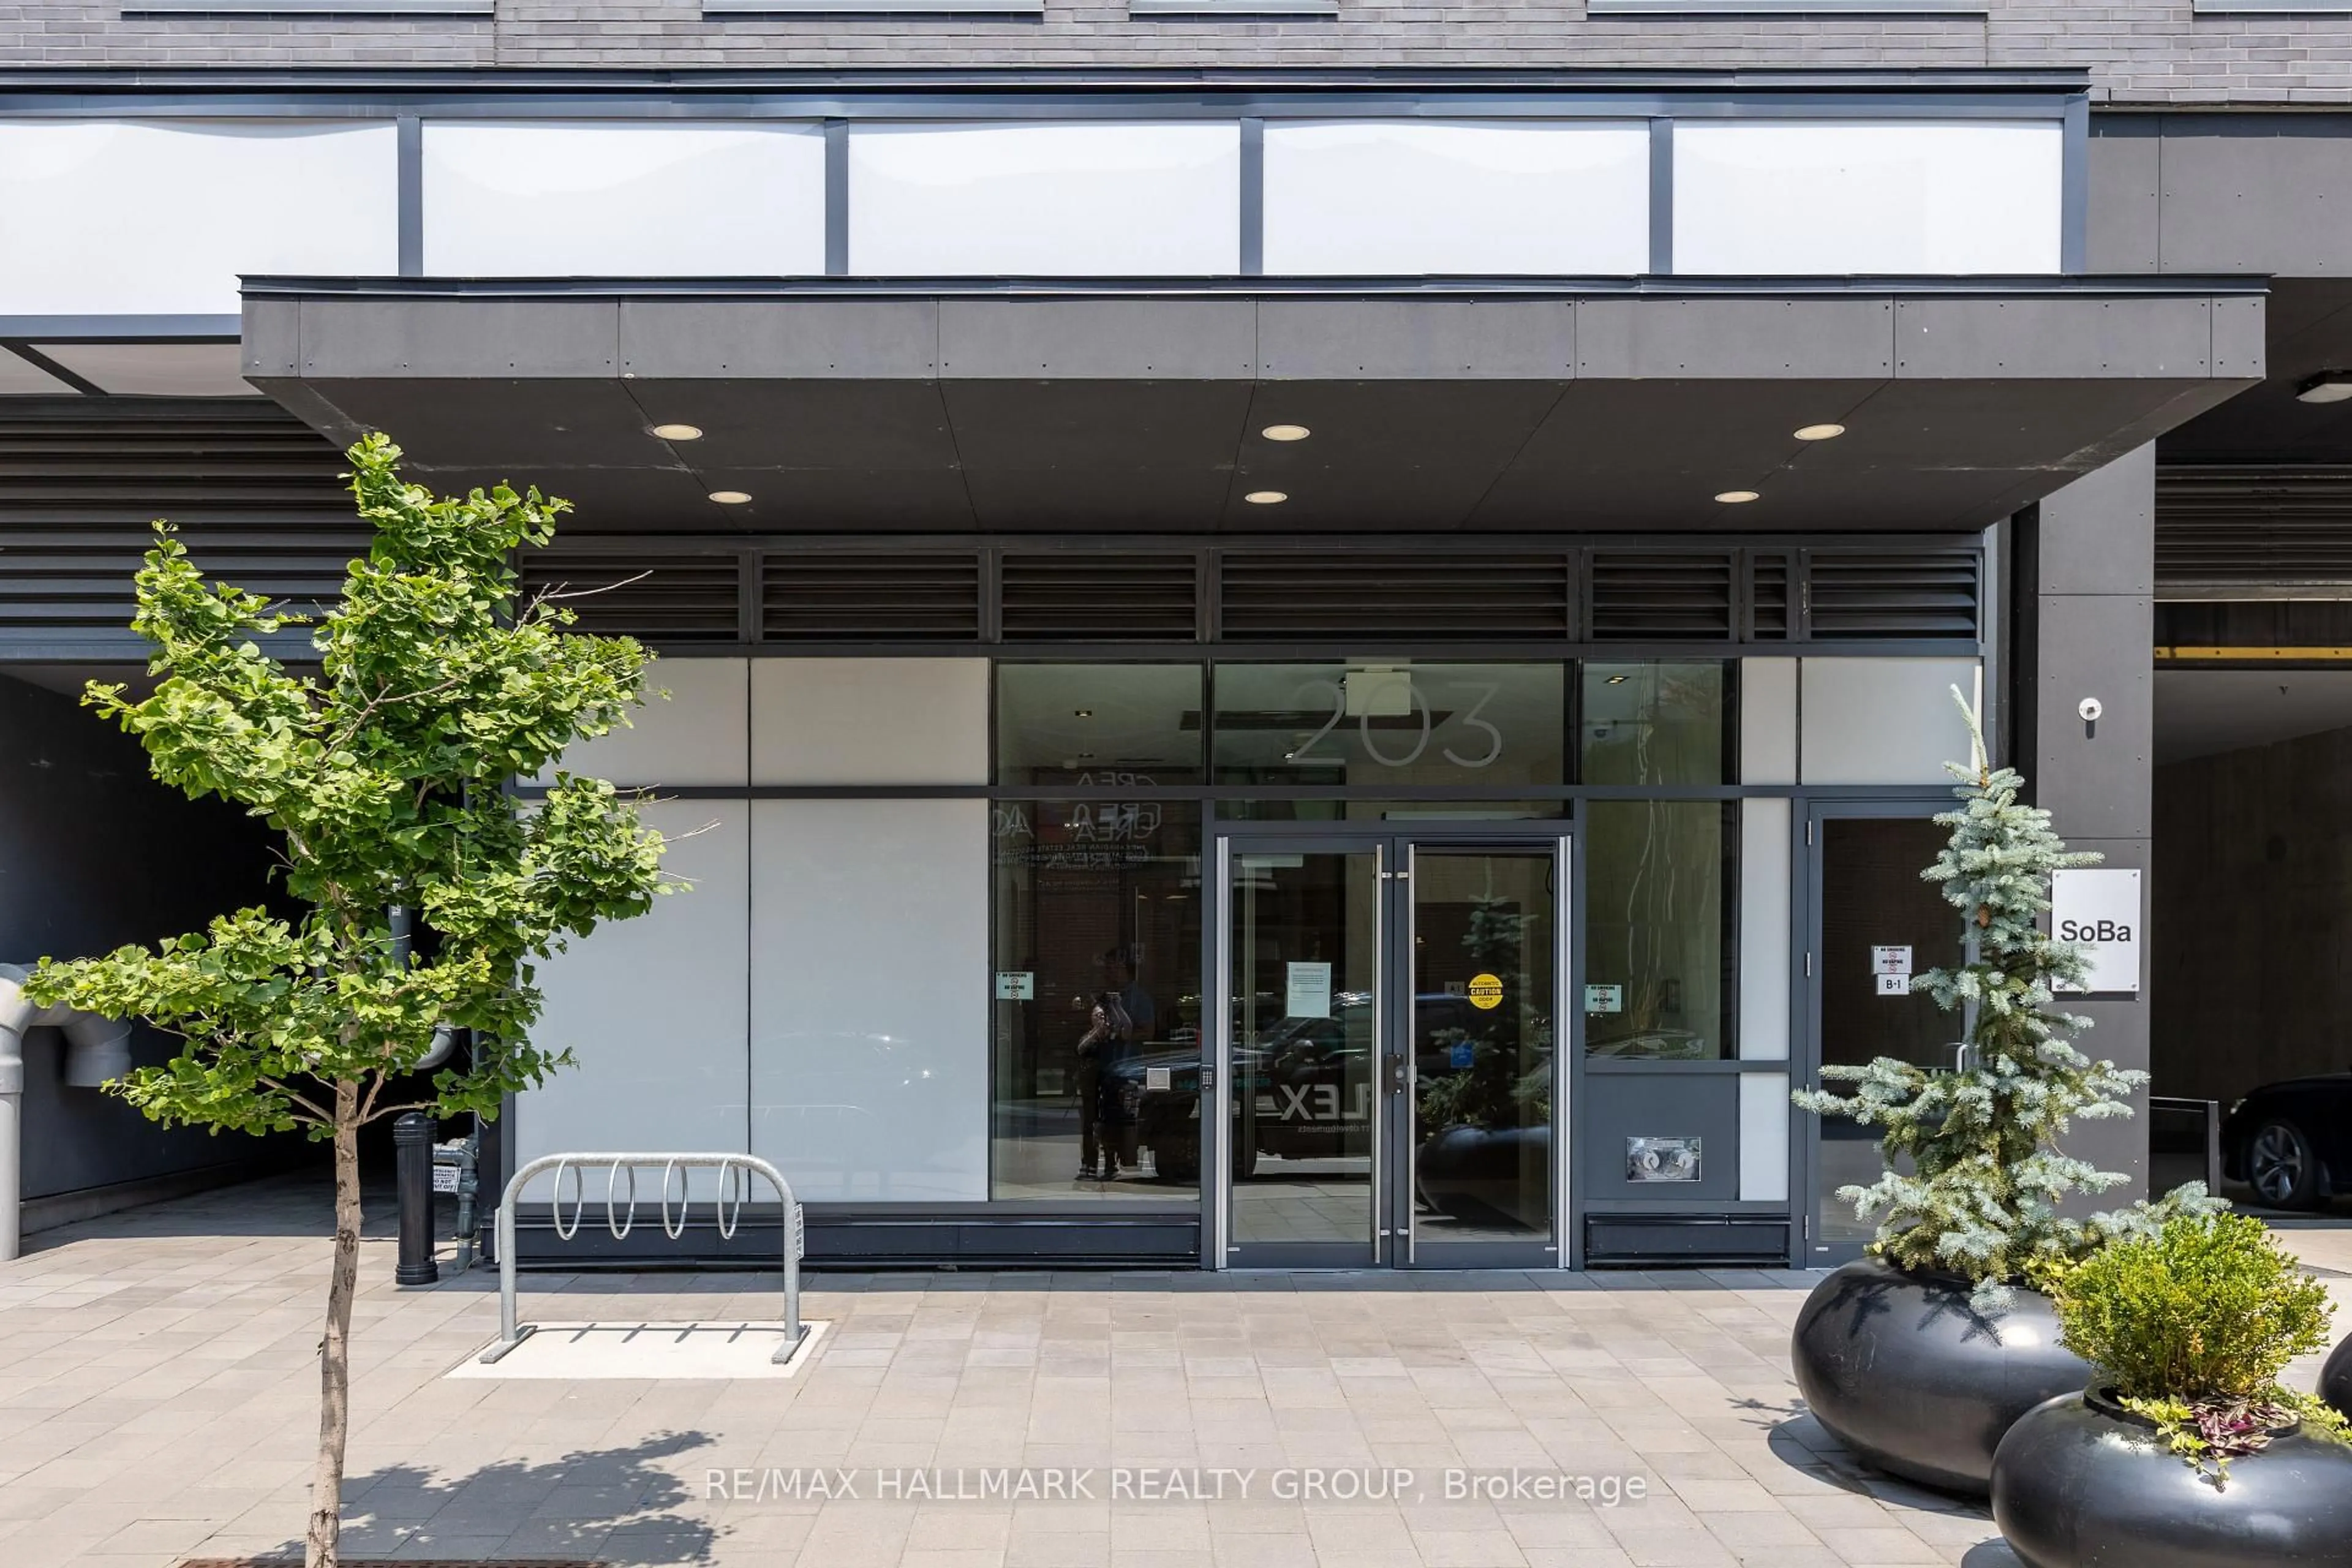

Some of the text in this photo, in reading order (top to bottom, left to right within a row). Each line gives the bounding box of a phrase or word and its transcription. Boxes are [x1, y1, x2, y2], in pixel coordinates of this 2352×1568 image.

[1287, 679, 1502, 767] 203
[2060, 920, 2131, 941] SoBa
[1886, 979, 1901, 989] B-1
